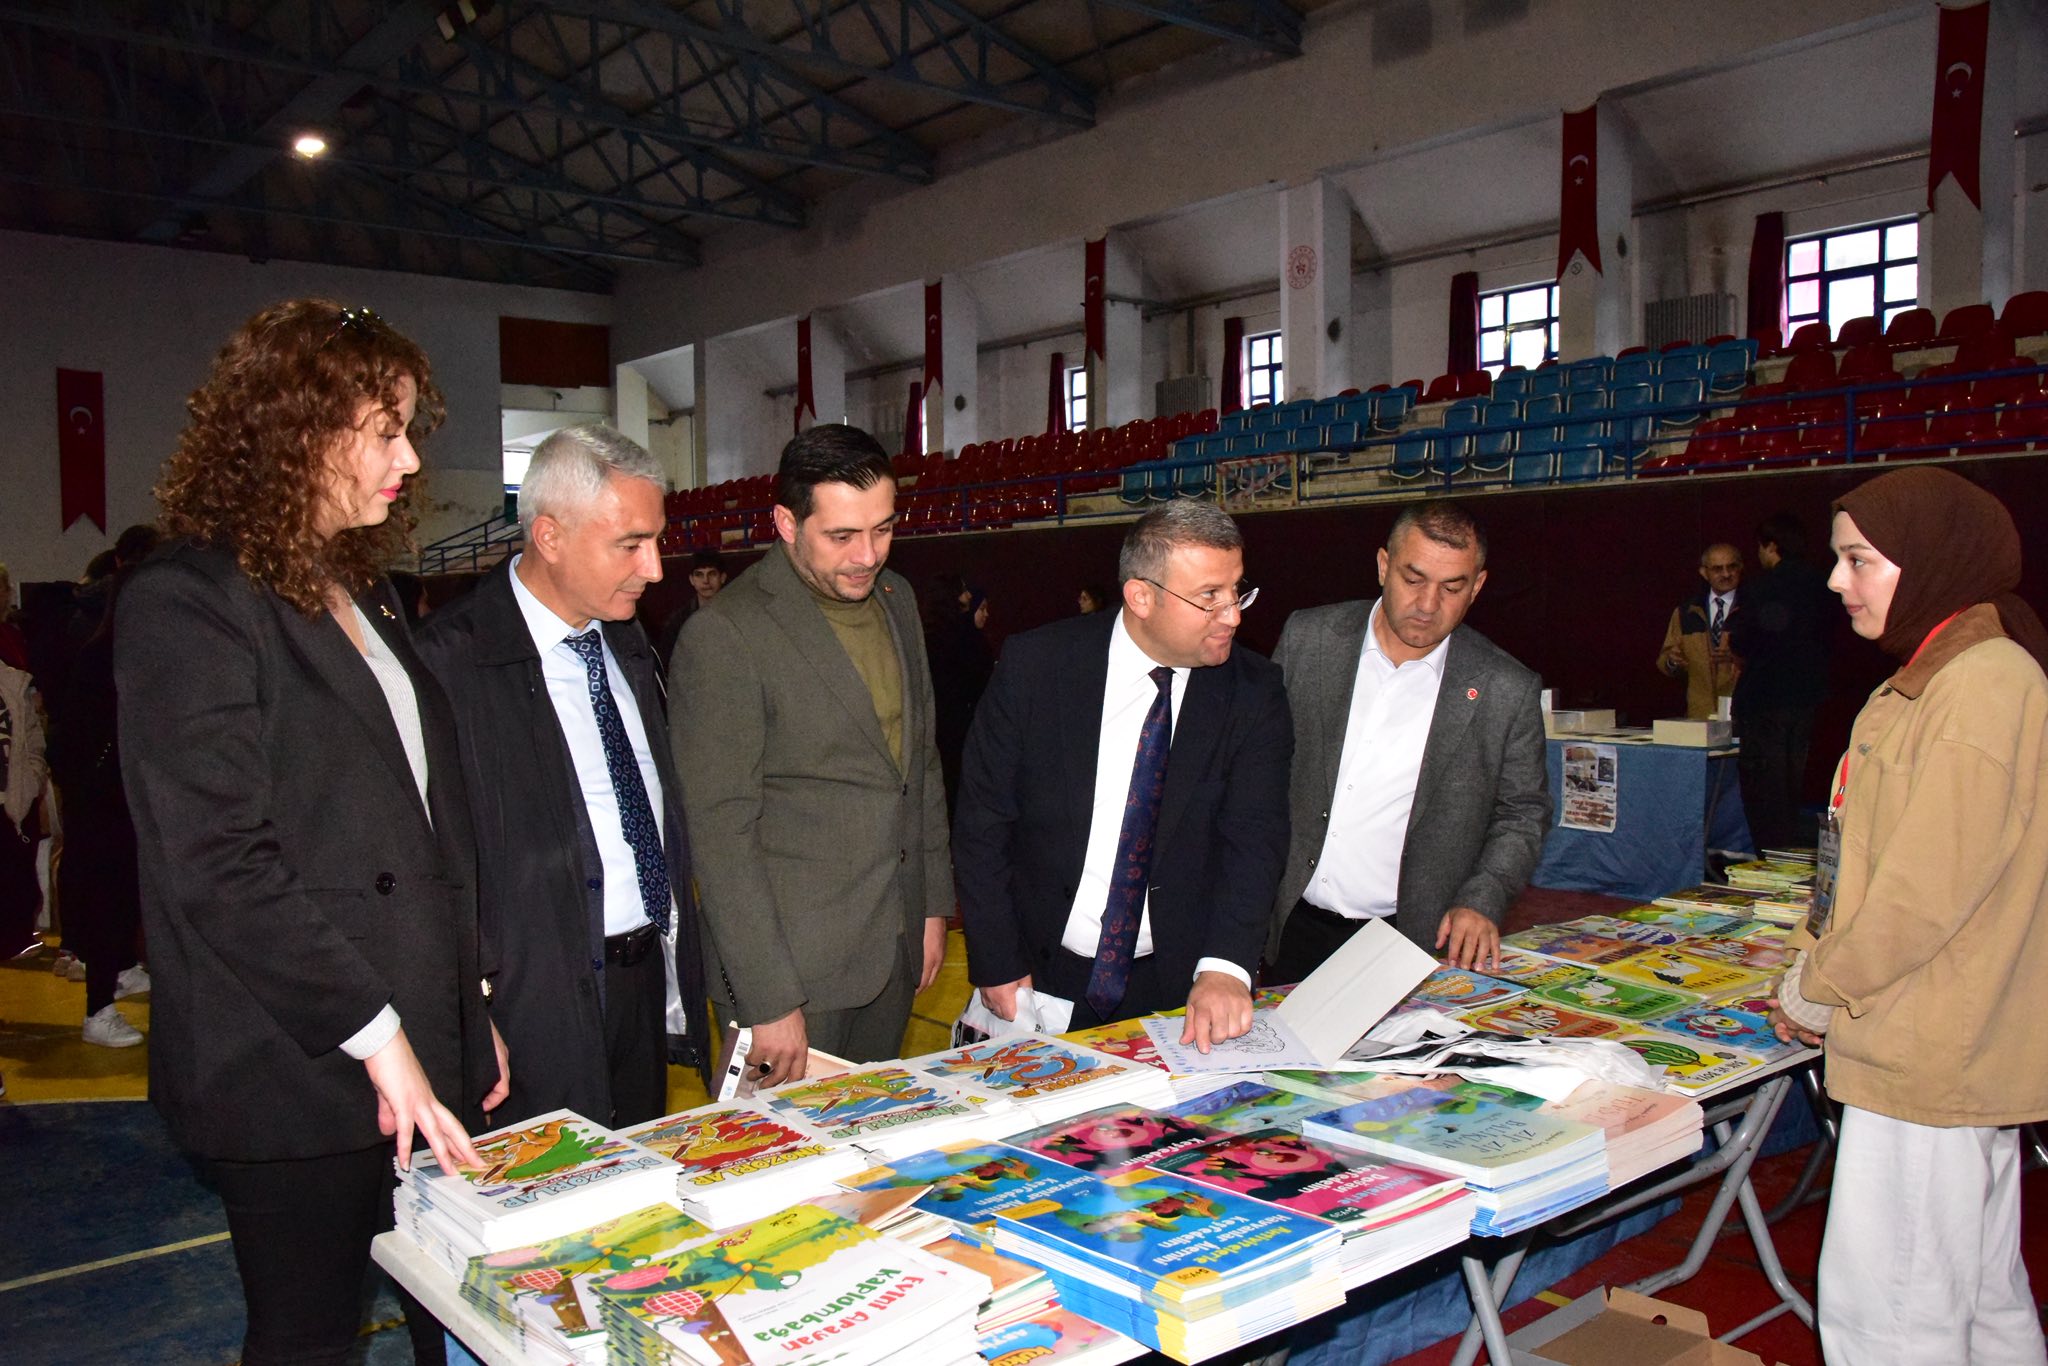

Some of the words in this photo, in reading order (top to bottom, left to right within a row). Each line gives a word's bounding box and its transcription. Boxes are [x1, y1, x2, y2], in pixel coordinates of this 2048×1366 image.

[497, 1156, 662, 1209] DİNOZORLAR
[1298, 1163, 1384, 1194] Keşfedelim
[1332, 1173, 1390, 1194] Doğayı
[1157, 1215, 1250, 1249] Keşfedelim
[1216, 1214, 1293, 1244] Hayvanlar
[1152, 1238, 1219, 1267] Alemini
[780, 1311, 871, 1352] Arayan
